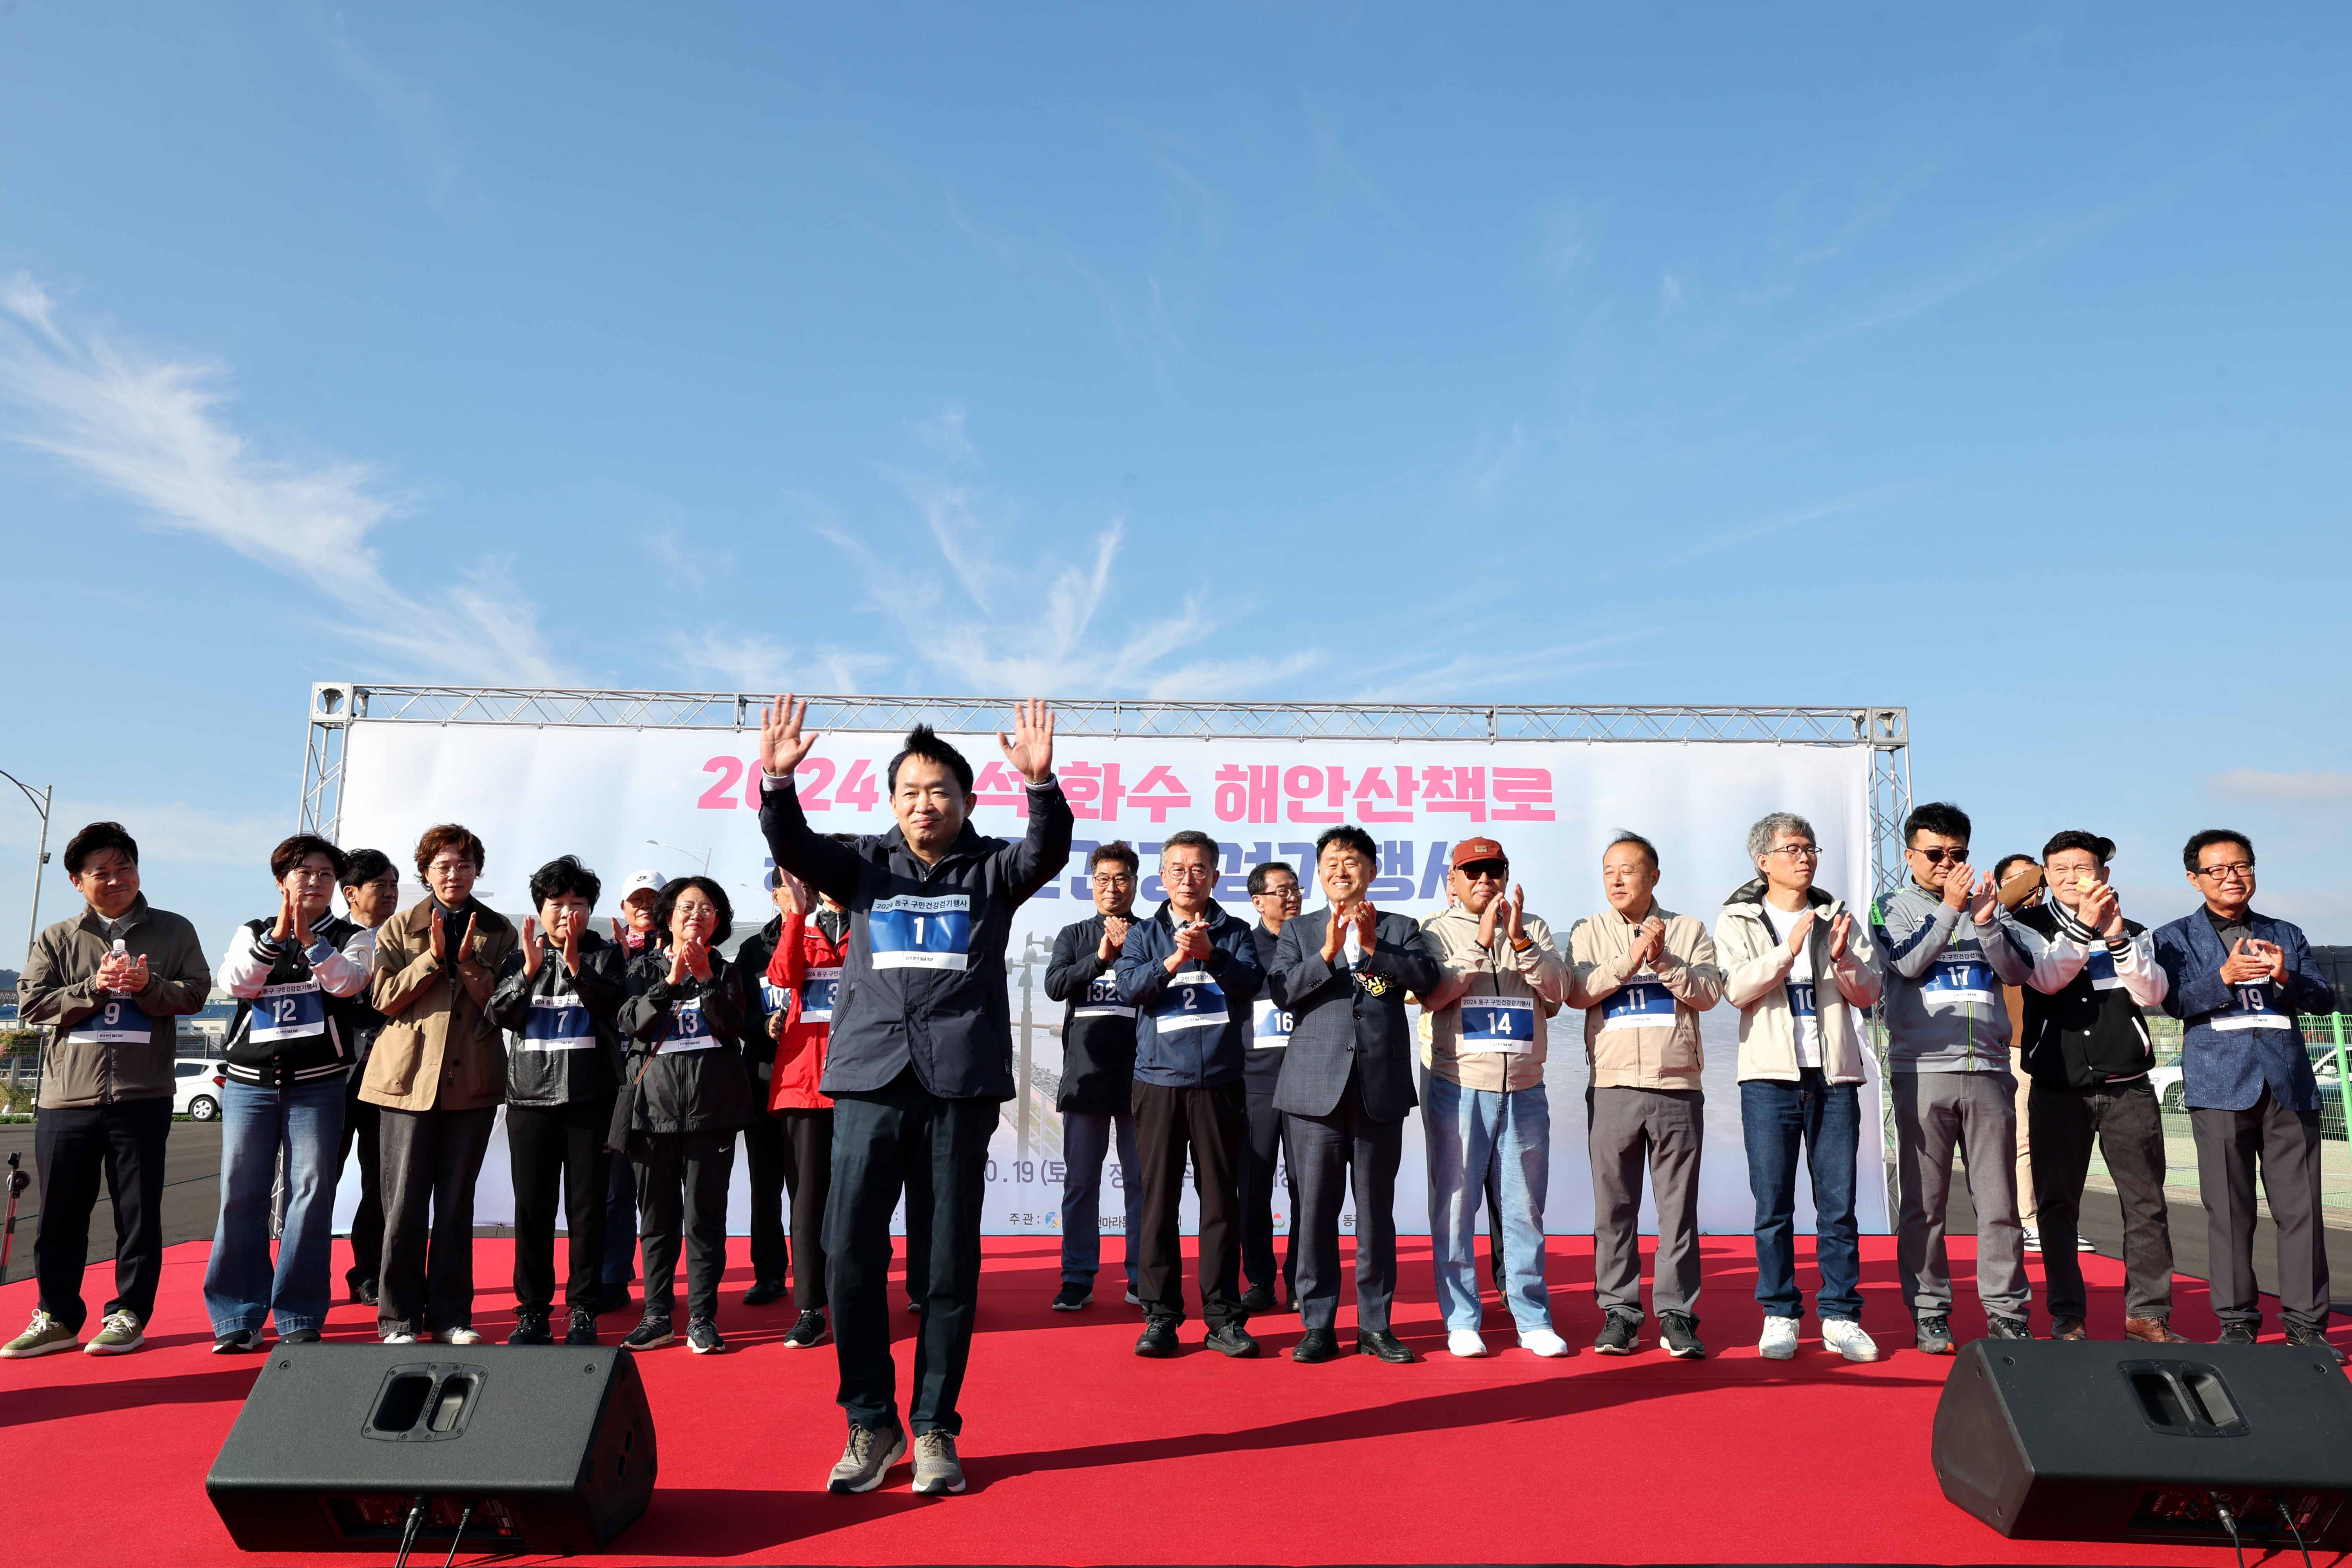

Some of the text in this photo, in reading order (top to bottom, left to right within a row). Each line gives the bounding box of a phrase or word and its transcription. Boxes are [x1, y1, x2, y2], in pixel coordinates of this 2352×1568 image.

[1215, 764, 1556, 823] 해안산책로
[911, 899, 967, 909] 구민건강걷기행사
[914, 917, 924, 944] 1
[1947, 966, 1971, 986] 17
[276, 982, 318, 994] 구민건강걷기행사
[828, 983, 838, 1005] 3
[1087, 982, 1124, 1002] 132
[1183, 988, 1197, 1010] 2
[1627, 988, 1646, 1010] 11
[2239, 988, 2264, 1010] 19
[104, 1002, 120, 1025] 9
[272, 999, 296, 1023] 12
[557, 1011, 568, 1033] 7
[1274, 1012, 1293, 1032] 16
[676, 1012, 698, 1035] 13
[1487, 1012, 1512, 1035] 14
[1343, 1214, 1357, 1227] 동
